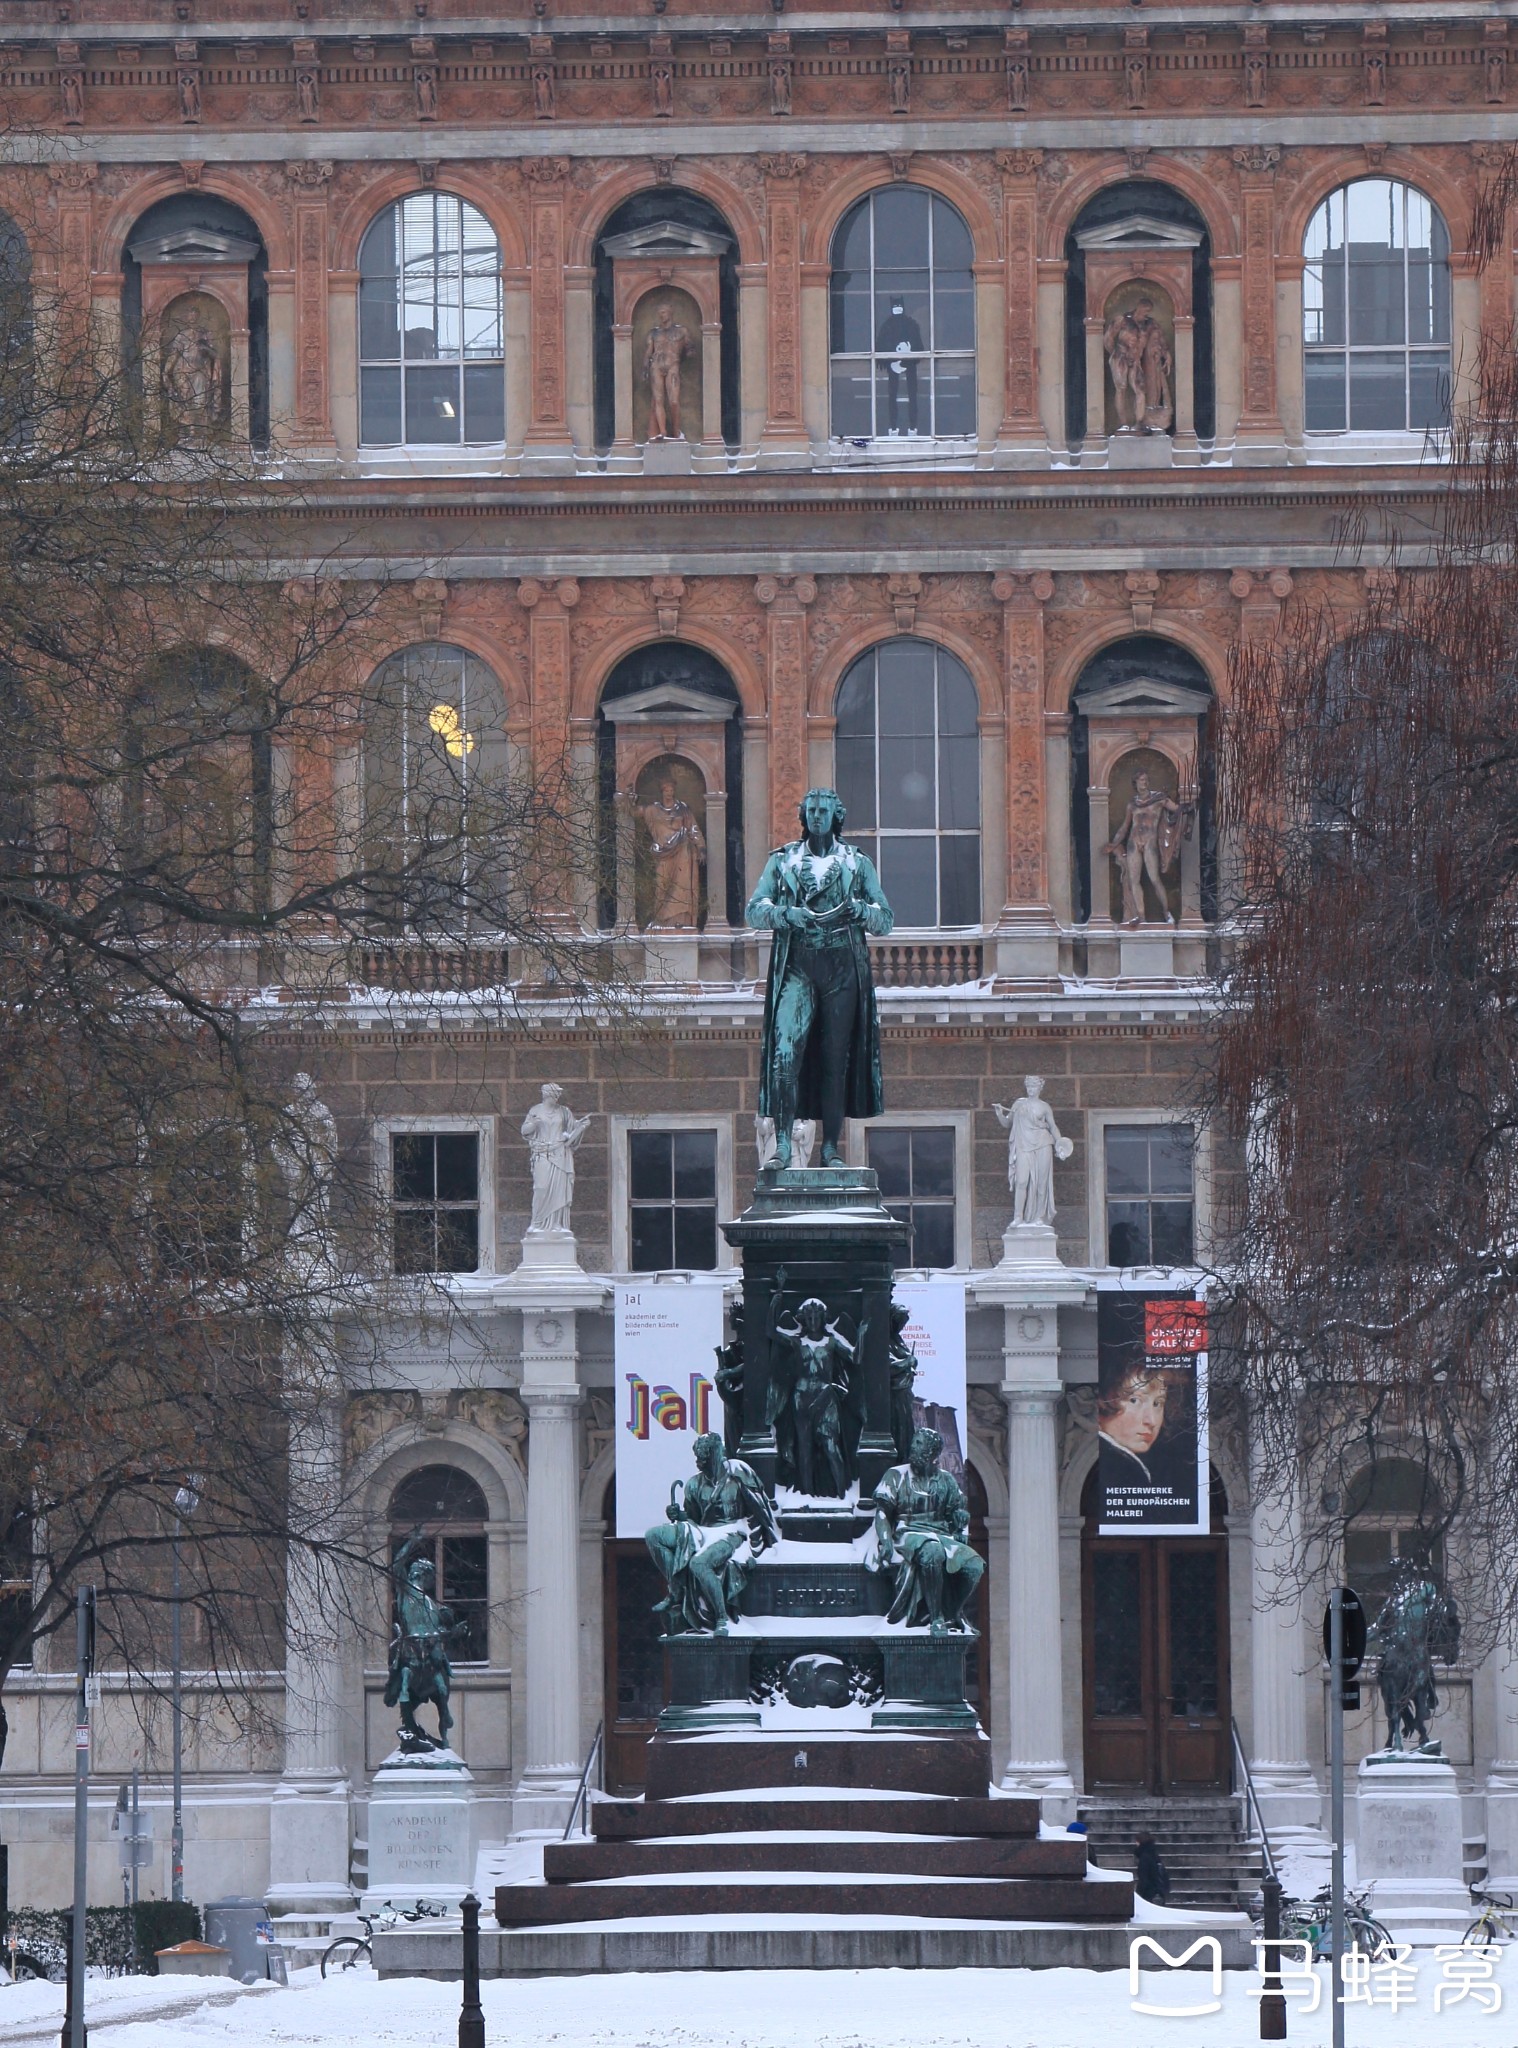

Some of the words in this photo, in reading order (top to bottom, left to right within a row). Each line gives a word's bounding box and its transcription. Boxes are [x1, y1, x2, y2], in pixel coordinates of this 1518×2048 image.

[1151, 1339, 1196, 1348] GALEIE
[1106, 1498, 1123, 1506] DER
[1126, 1496, 1191, 1506] EUROPÄISCHEN
